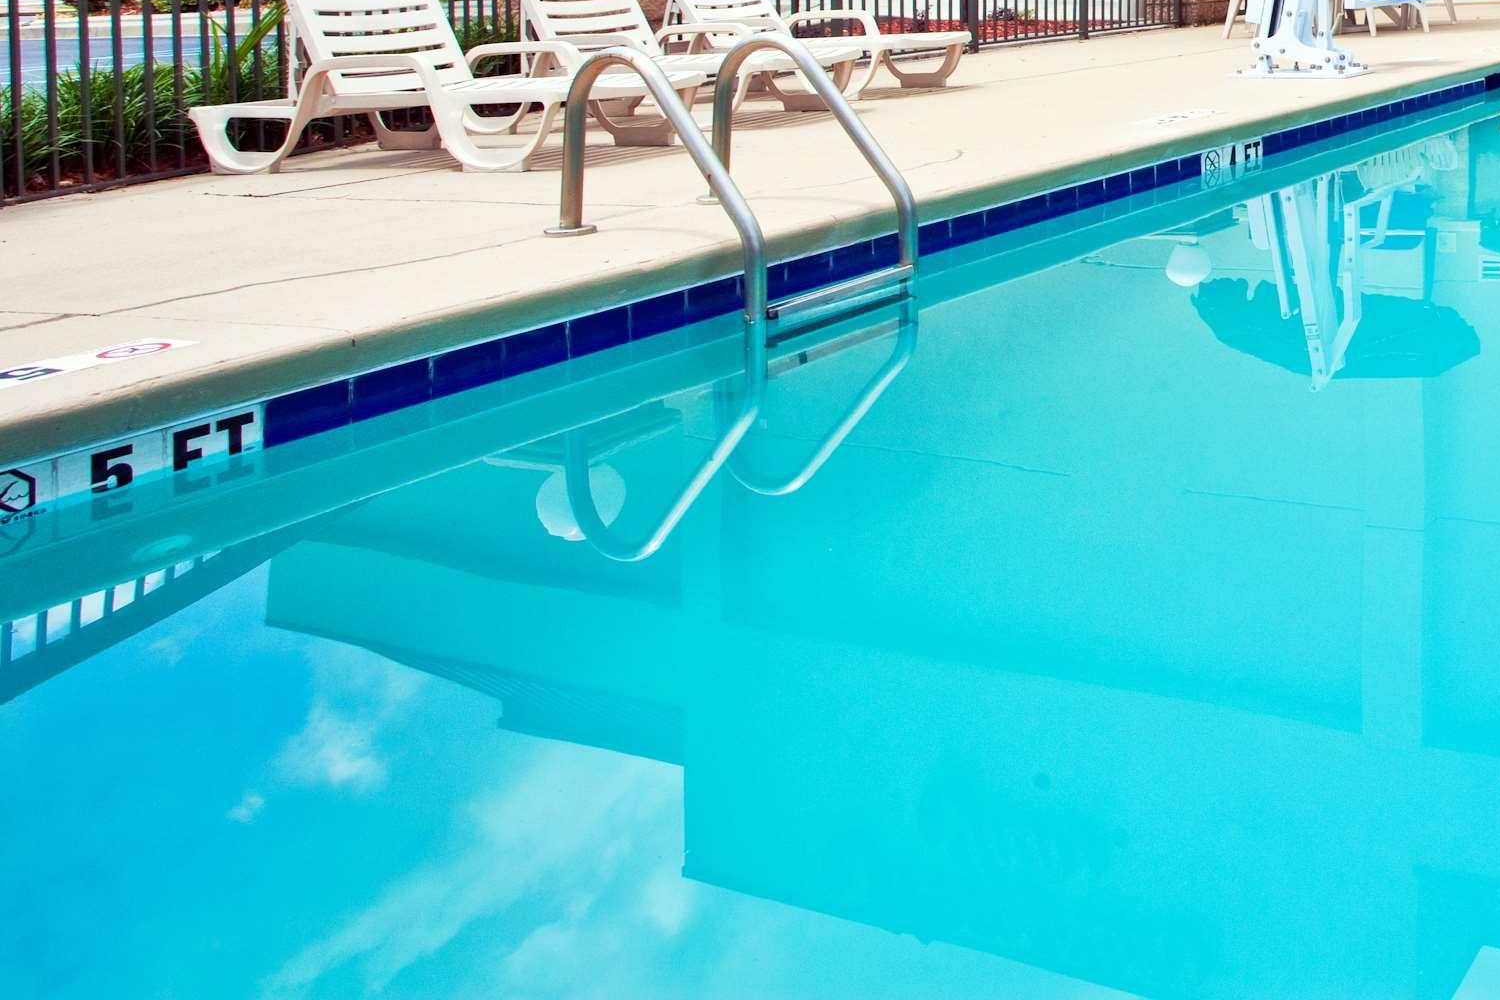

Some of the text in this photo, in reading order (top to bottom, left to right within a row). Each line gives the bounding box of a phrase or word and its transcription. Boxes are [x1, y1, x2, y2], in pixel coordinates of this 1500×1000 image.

[1244, 141, 1260, 162] FT
[90, 411, 254, 494] 5 FT
